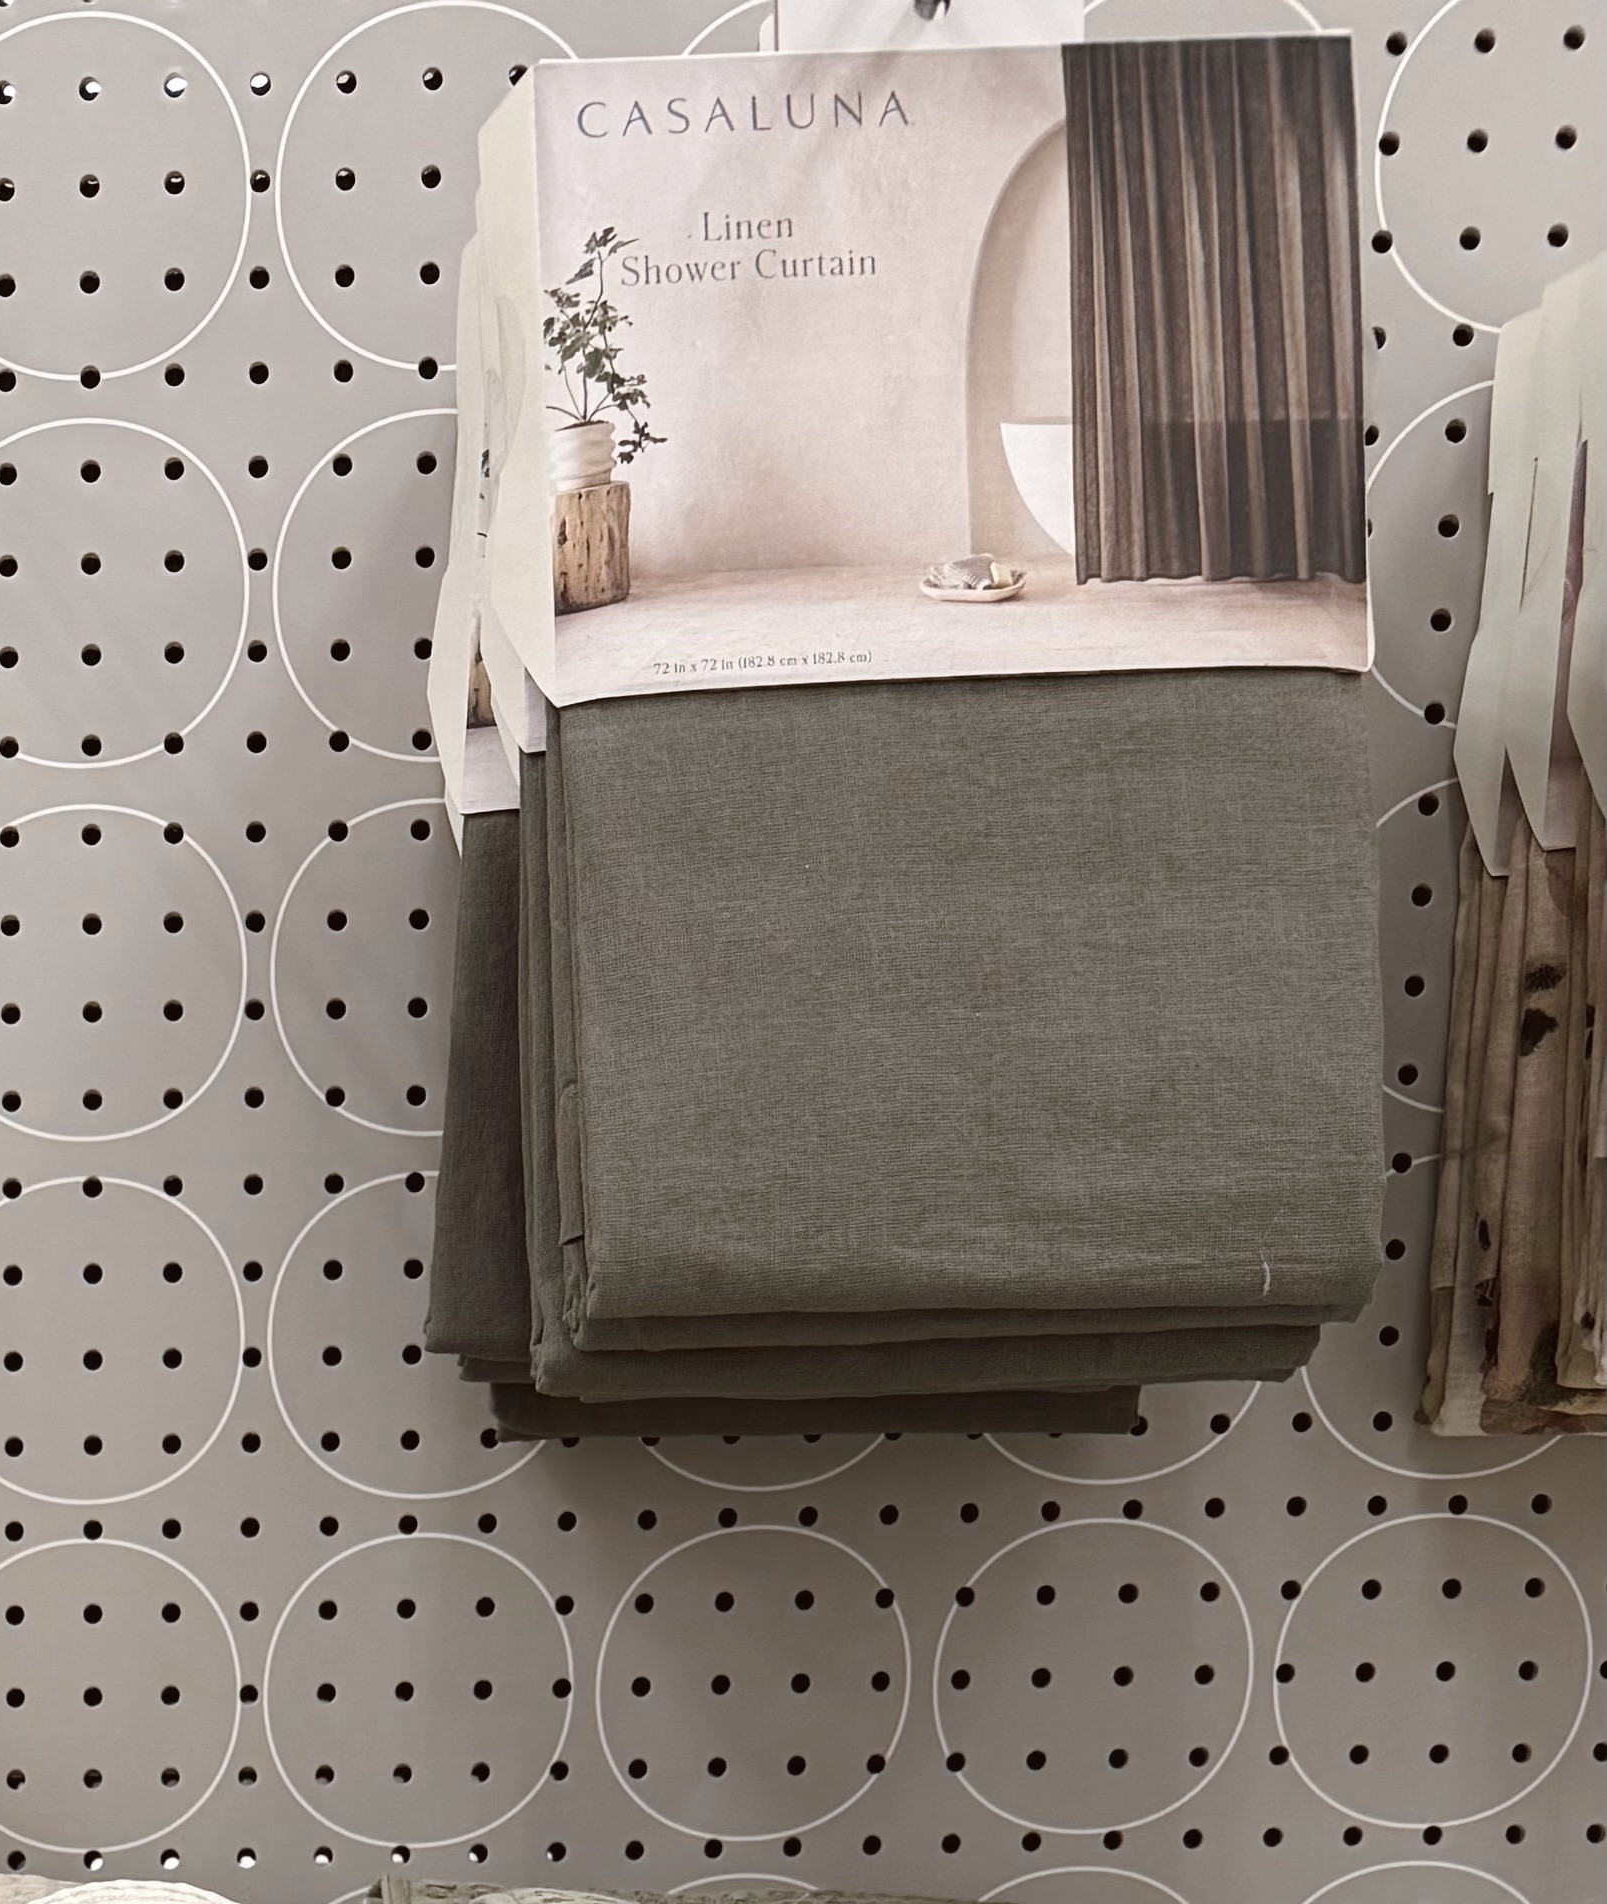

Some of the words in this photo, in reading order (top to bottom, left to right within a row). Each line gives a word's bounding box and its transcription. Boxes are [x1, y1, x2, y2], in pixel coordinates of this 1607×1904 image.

[577, 90, 910, 138] CASALUNA
[703, 211, 793, 242] Linen
[621, 254, 741, 287] Shower
[755, 249, 876, 279] Curtain
[653, 663, 670, 675] 72
[701, 659, 717, 672] 72
[738, 655, 775, 669] (182.8
[780, 657, 796, 667] cm
[813, 652, 845, 665] 182.8
[850, 650, 872, 663] cm)
